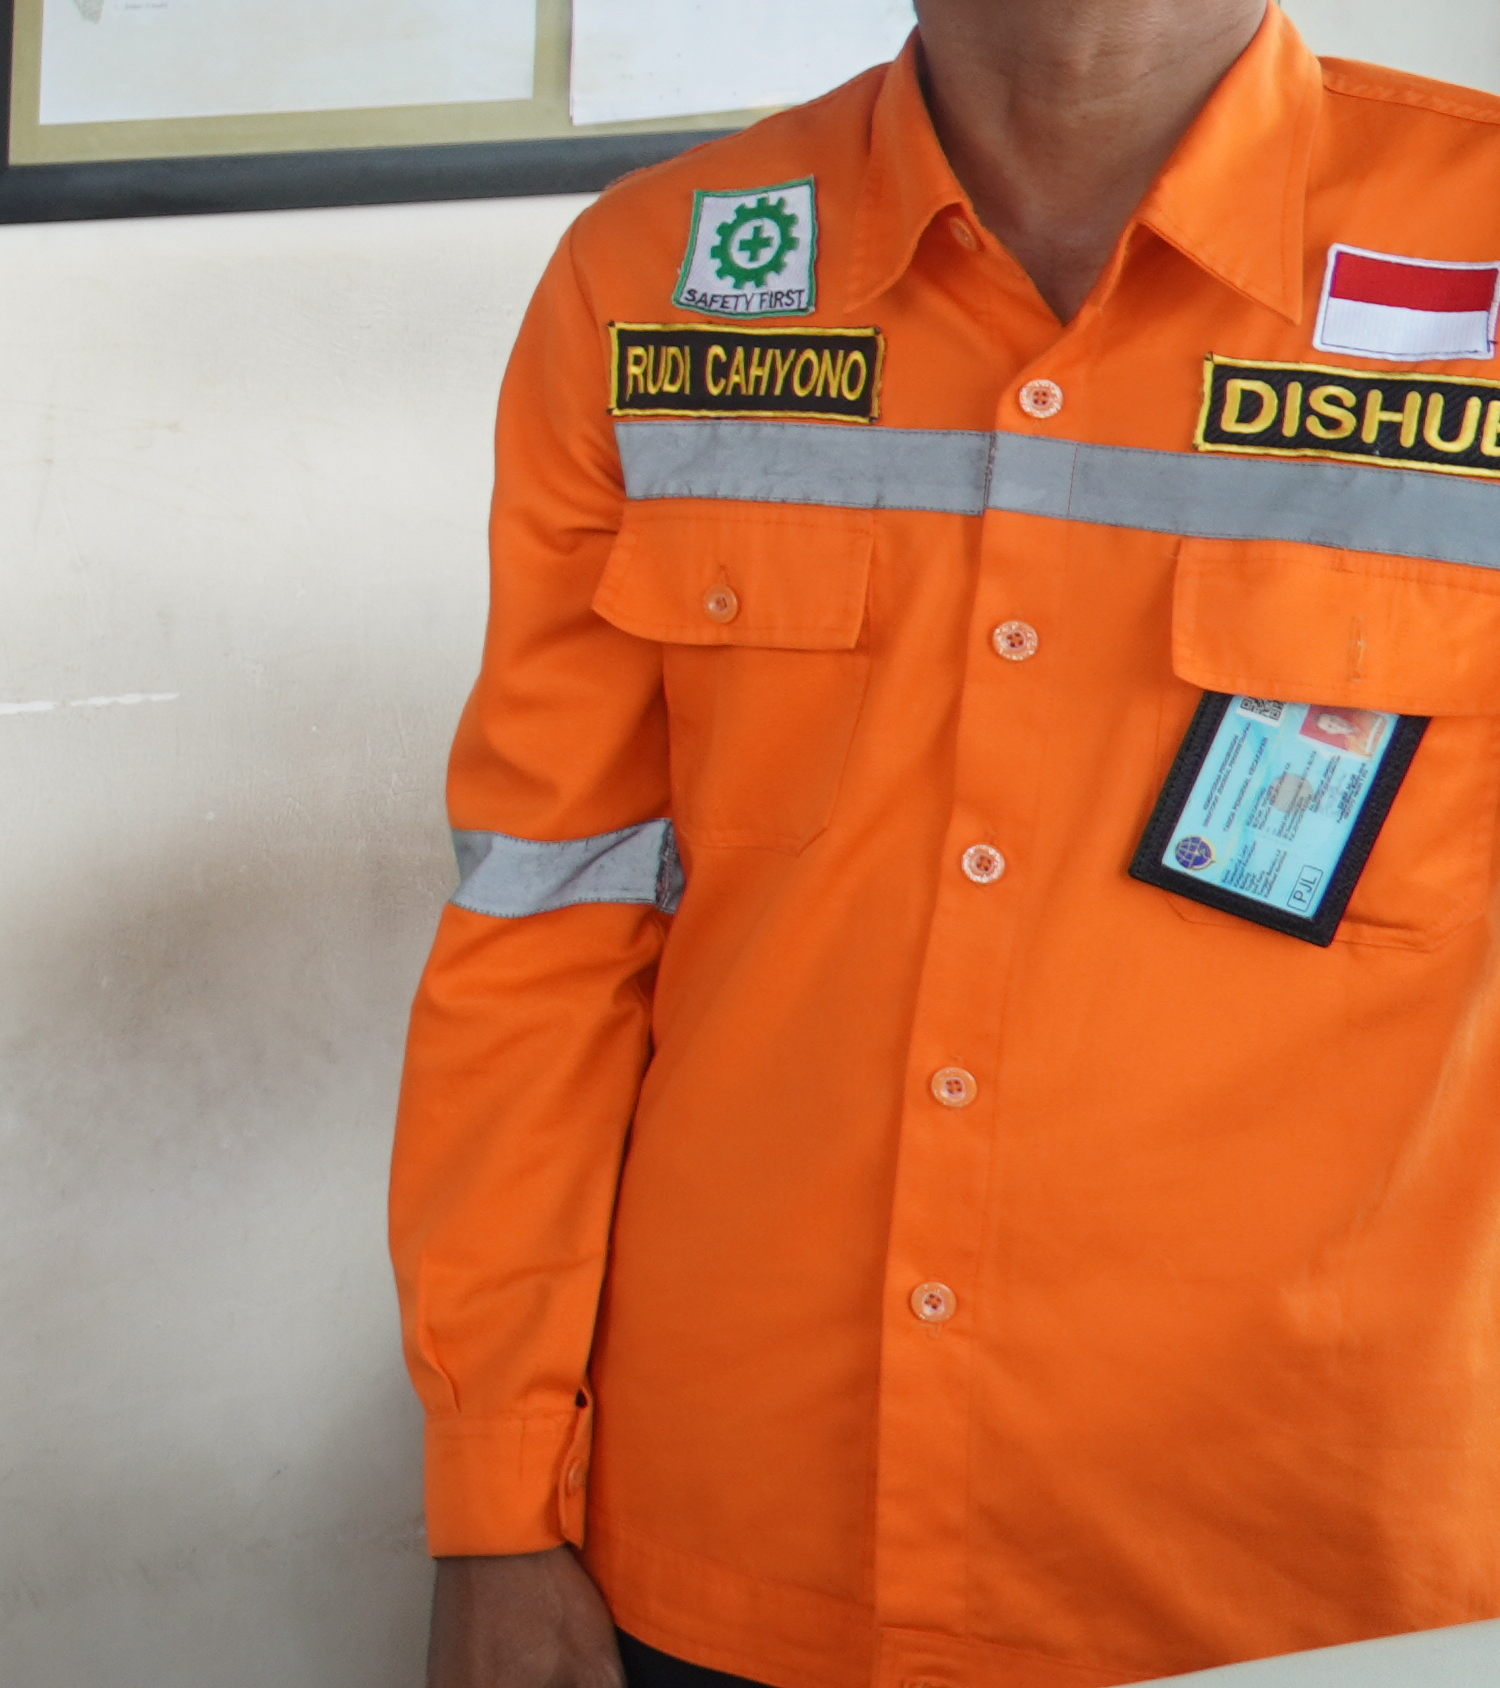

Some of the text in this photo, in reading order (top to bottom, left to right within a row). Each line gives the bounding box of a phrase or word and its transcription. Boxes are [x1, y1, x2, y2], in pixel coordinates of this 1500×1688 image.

[684, 287, 806, 312] SAFETY FIRST
[625, 344, 868, 401] RUDI CAHYONO
[1291, 872, 1316, 905] PJL
